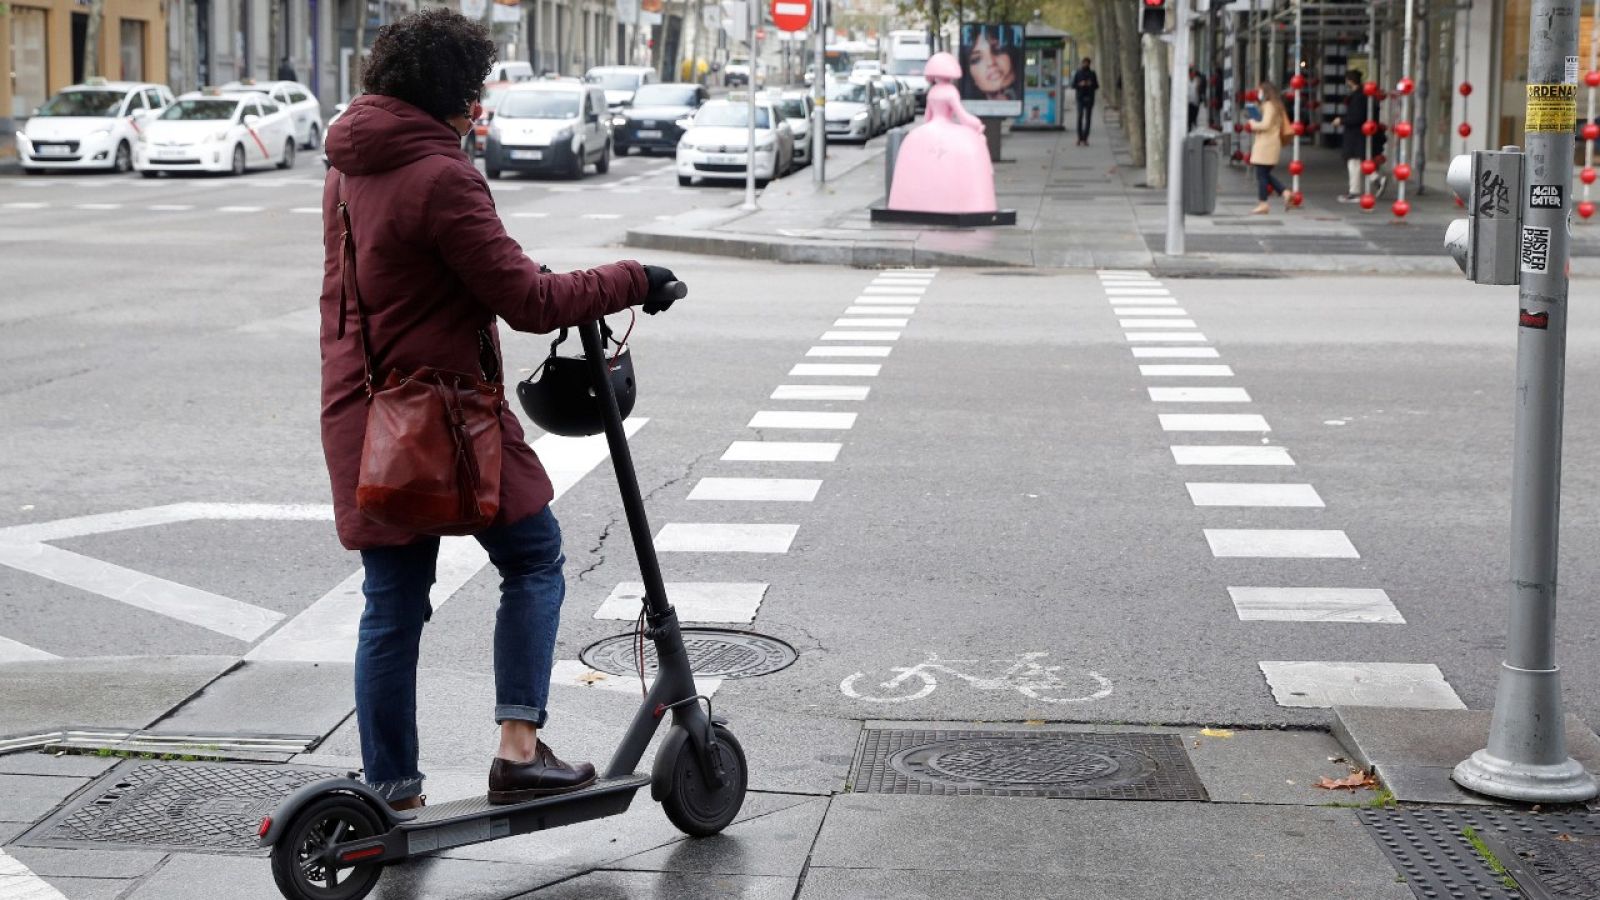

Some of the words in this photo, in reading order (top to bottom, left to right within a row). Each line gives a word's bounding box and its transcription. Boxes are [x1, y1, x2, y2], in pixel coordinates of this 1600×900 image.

[1532, 186, 1558, 195] ACID
[1531, 196, 1561, 206] EATER
[1531, 229, 1549, 270] HASTER
